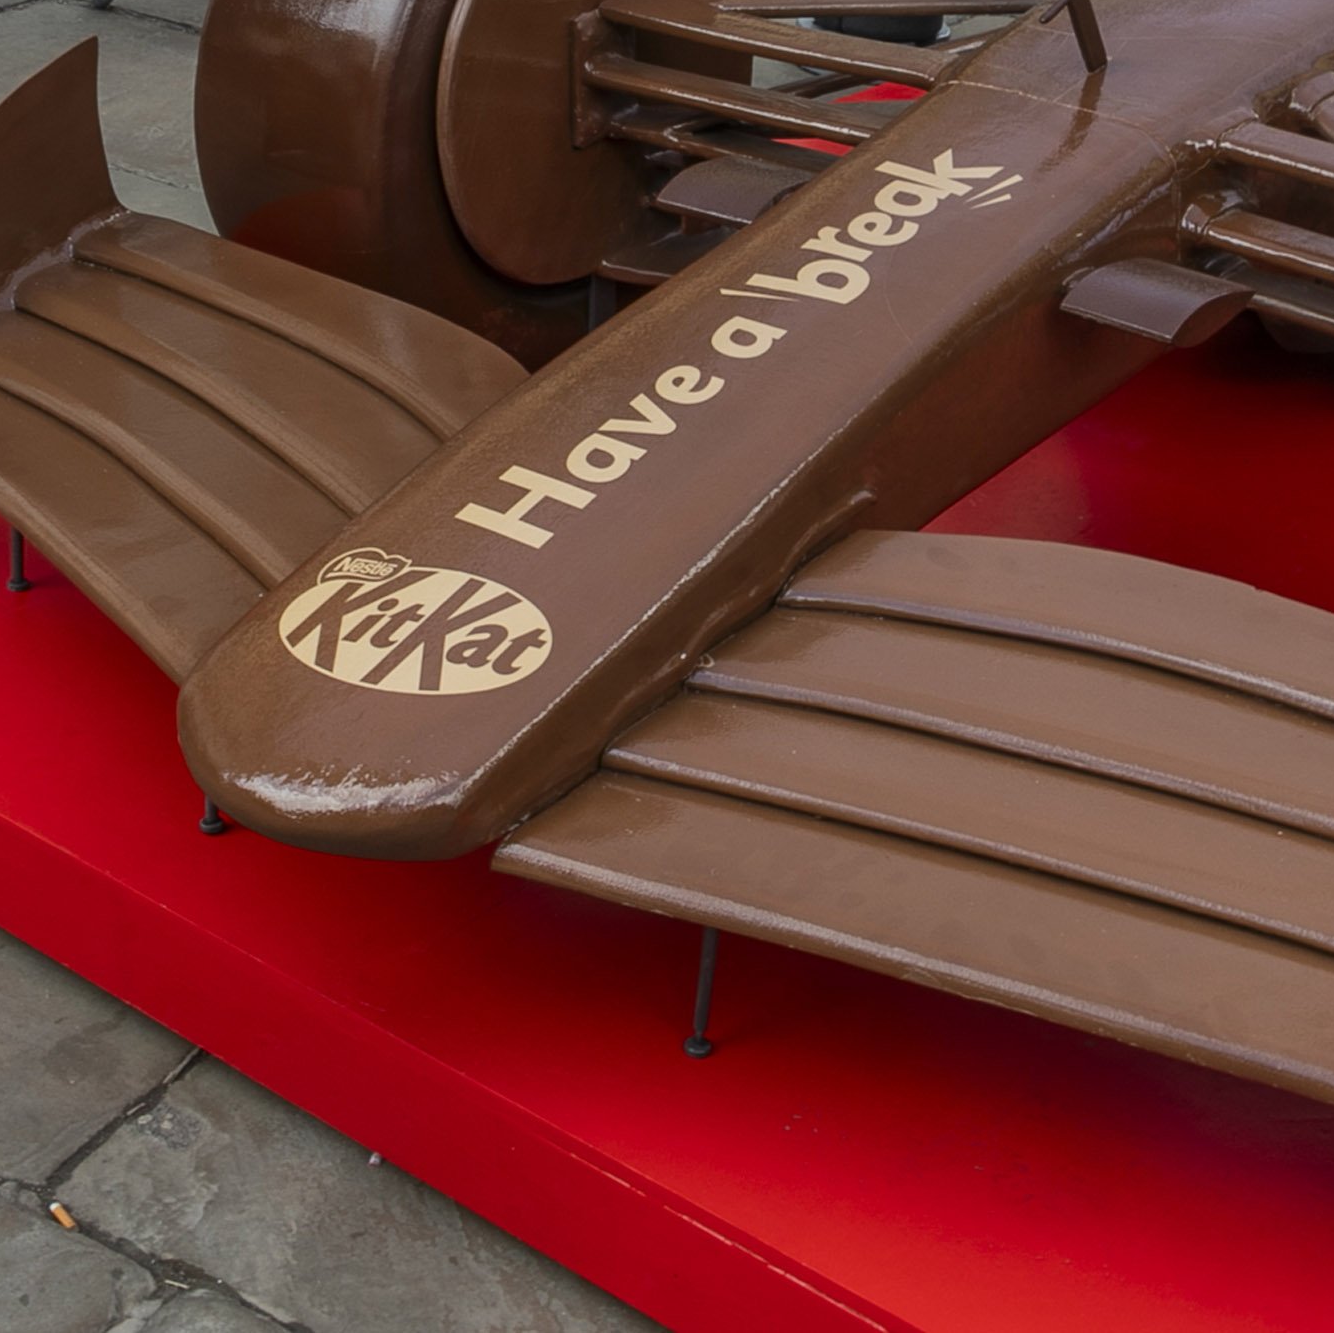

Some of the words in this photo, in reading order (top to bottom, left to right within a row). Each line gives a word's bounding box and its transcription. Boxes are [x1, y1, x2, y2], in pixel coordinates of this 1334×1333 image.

[745, 148, 1005, 306] break
[711, 315, 788, 359] a
[454, 365, 725, 550] Have
[285, 570, 549, 692] KitKat
